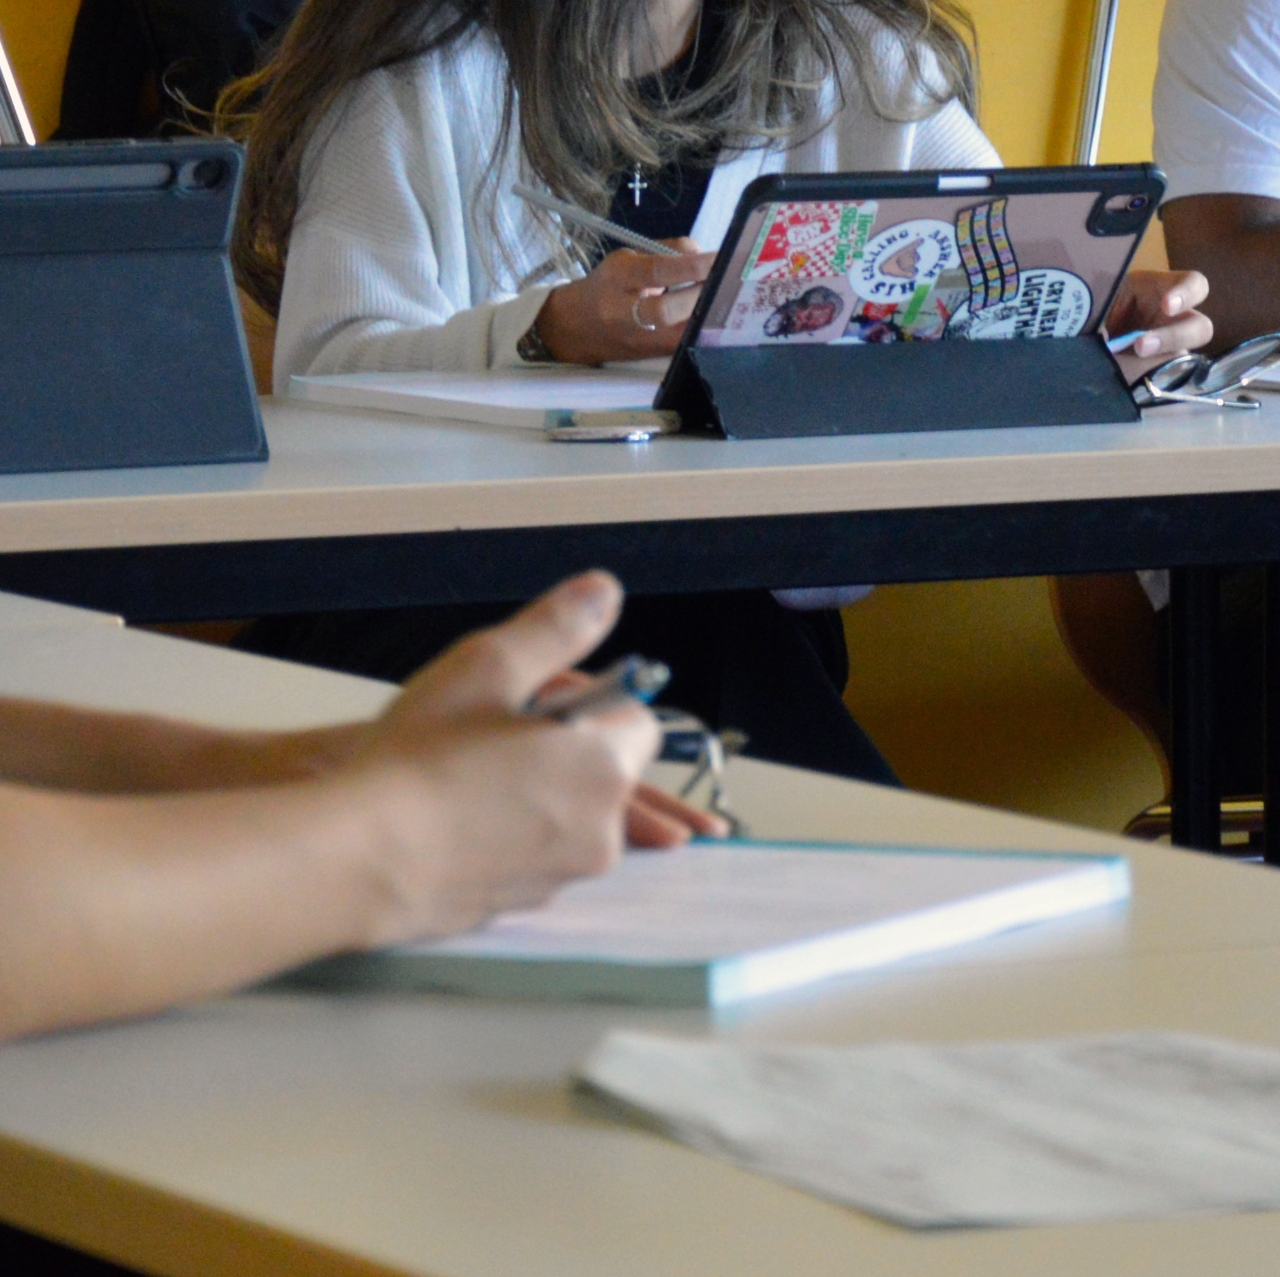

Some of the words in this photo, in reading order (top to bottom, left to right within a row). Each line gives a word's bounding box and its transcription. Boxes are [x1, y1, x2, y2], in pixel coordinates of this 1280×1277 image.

[838, 206, 858, 240] Slice
[861, 229, 909, 281] CALLING
[1044, 280, 1066, 305] CRY
[1060, 308, 1072, 321] TO
